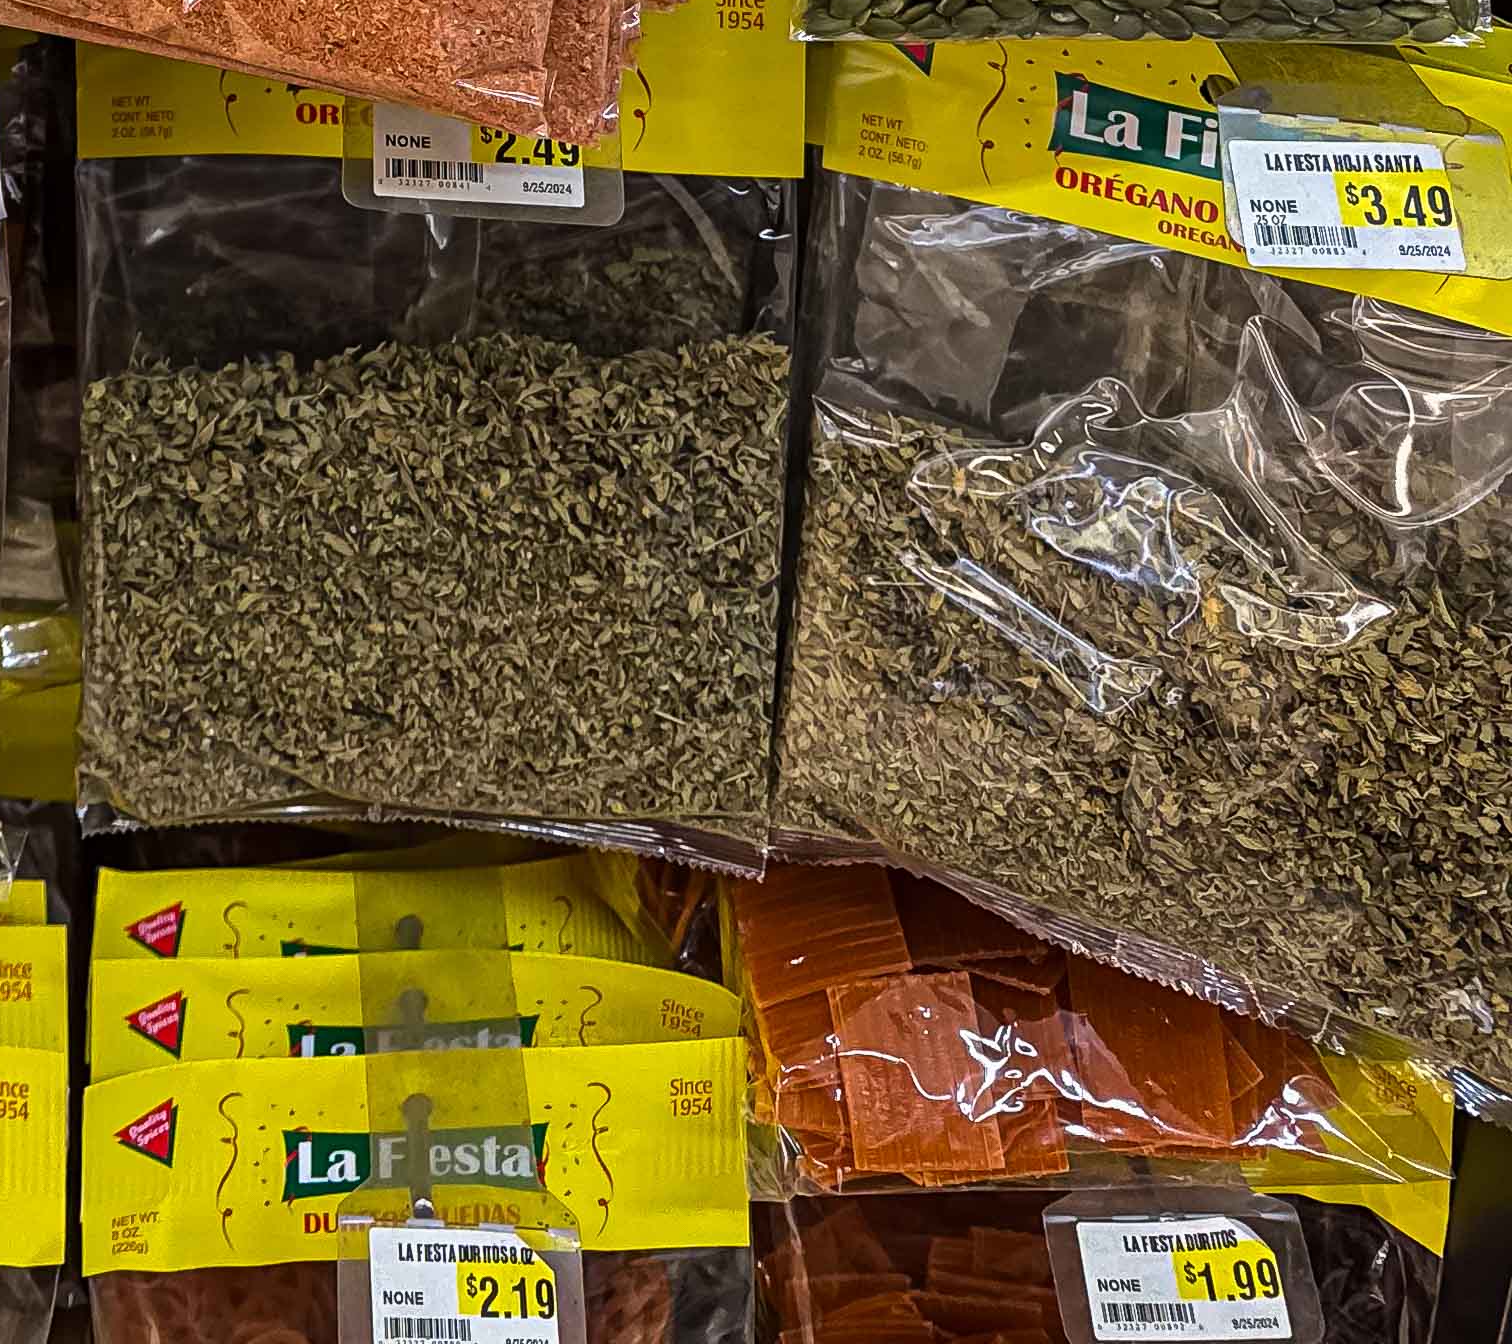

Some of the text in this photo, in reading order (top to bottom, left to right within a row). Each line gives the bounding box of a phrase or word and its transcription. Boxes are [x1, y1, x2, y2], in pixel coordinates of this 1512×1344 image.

[716, 10, 765, 30] 1954
[1070, 90, 1143, 151] La
[385, 134, 432, 149] NONE
[1265, 153, 1423, 173] LA FIESTA HOJA SANTA
[1055, 167, 1219, 224] ORÉGANO
[1250, 200, 1298, 213] NONE
[1345, 182, 1452, 227] $3.49
[661, 998, 704, 1022] Since
[661, 1013, 701, 1037] 1954
[670, 1078, 712, 1096] Since
[670, 1097, 712, 1117] 1954
[1123, 1229, 1238, 1253] LA FIESTA DURITOS
[1097, 1278, 1141, 1292] NONE
[1184, 1258, 1280, 1302] $1.99
[383, 1291, 424, 1306] NONE
[466, 1273, 555, 1319] $2.19
